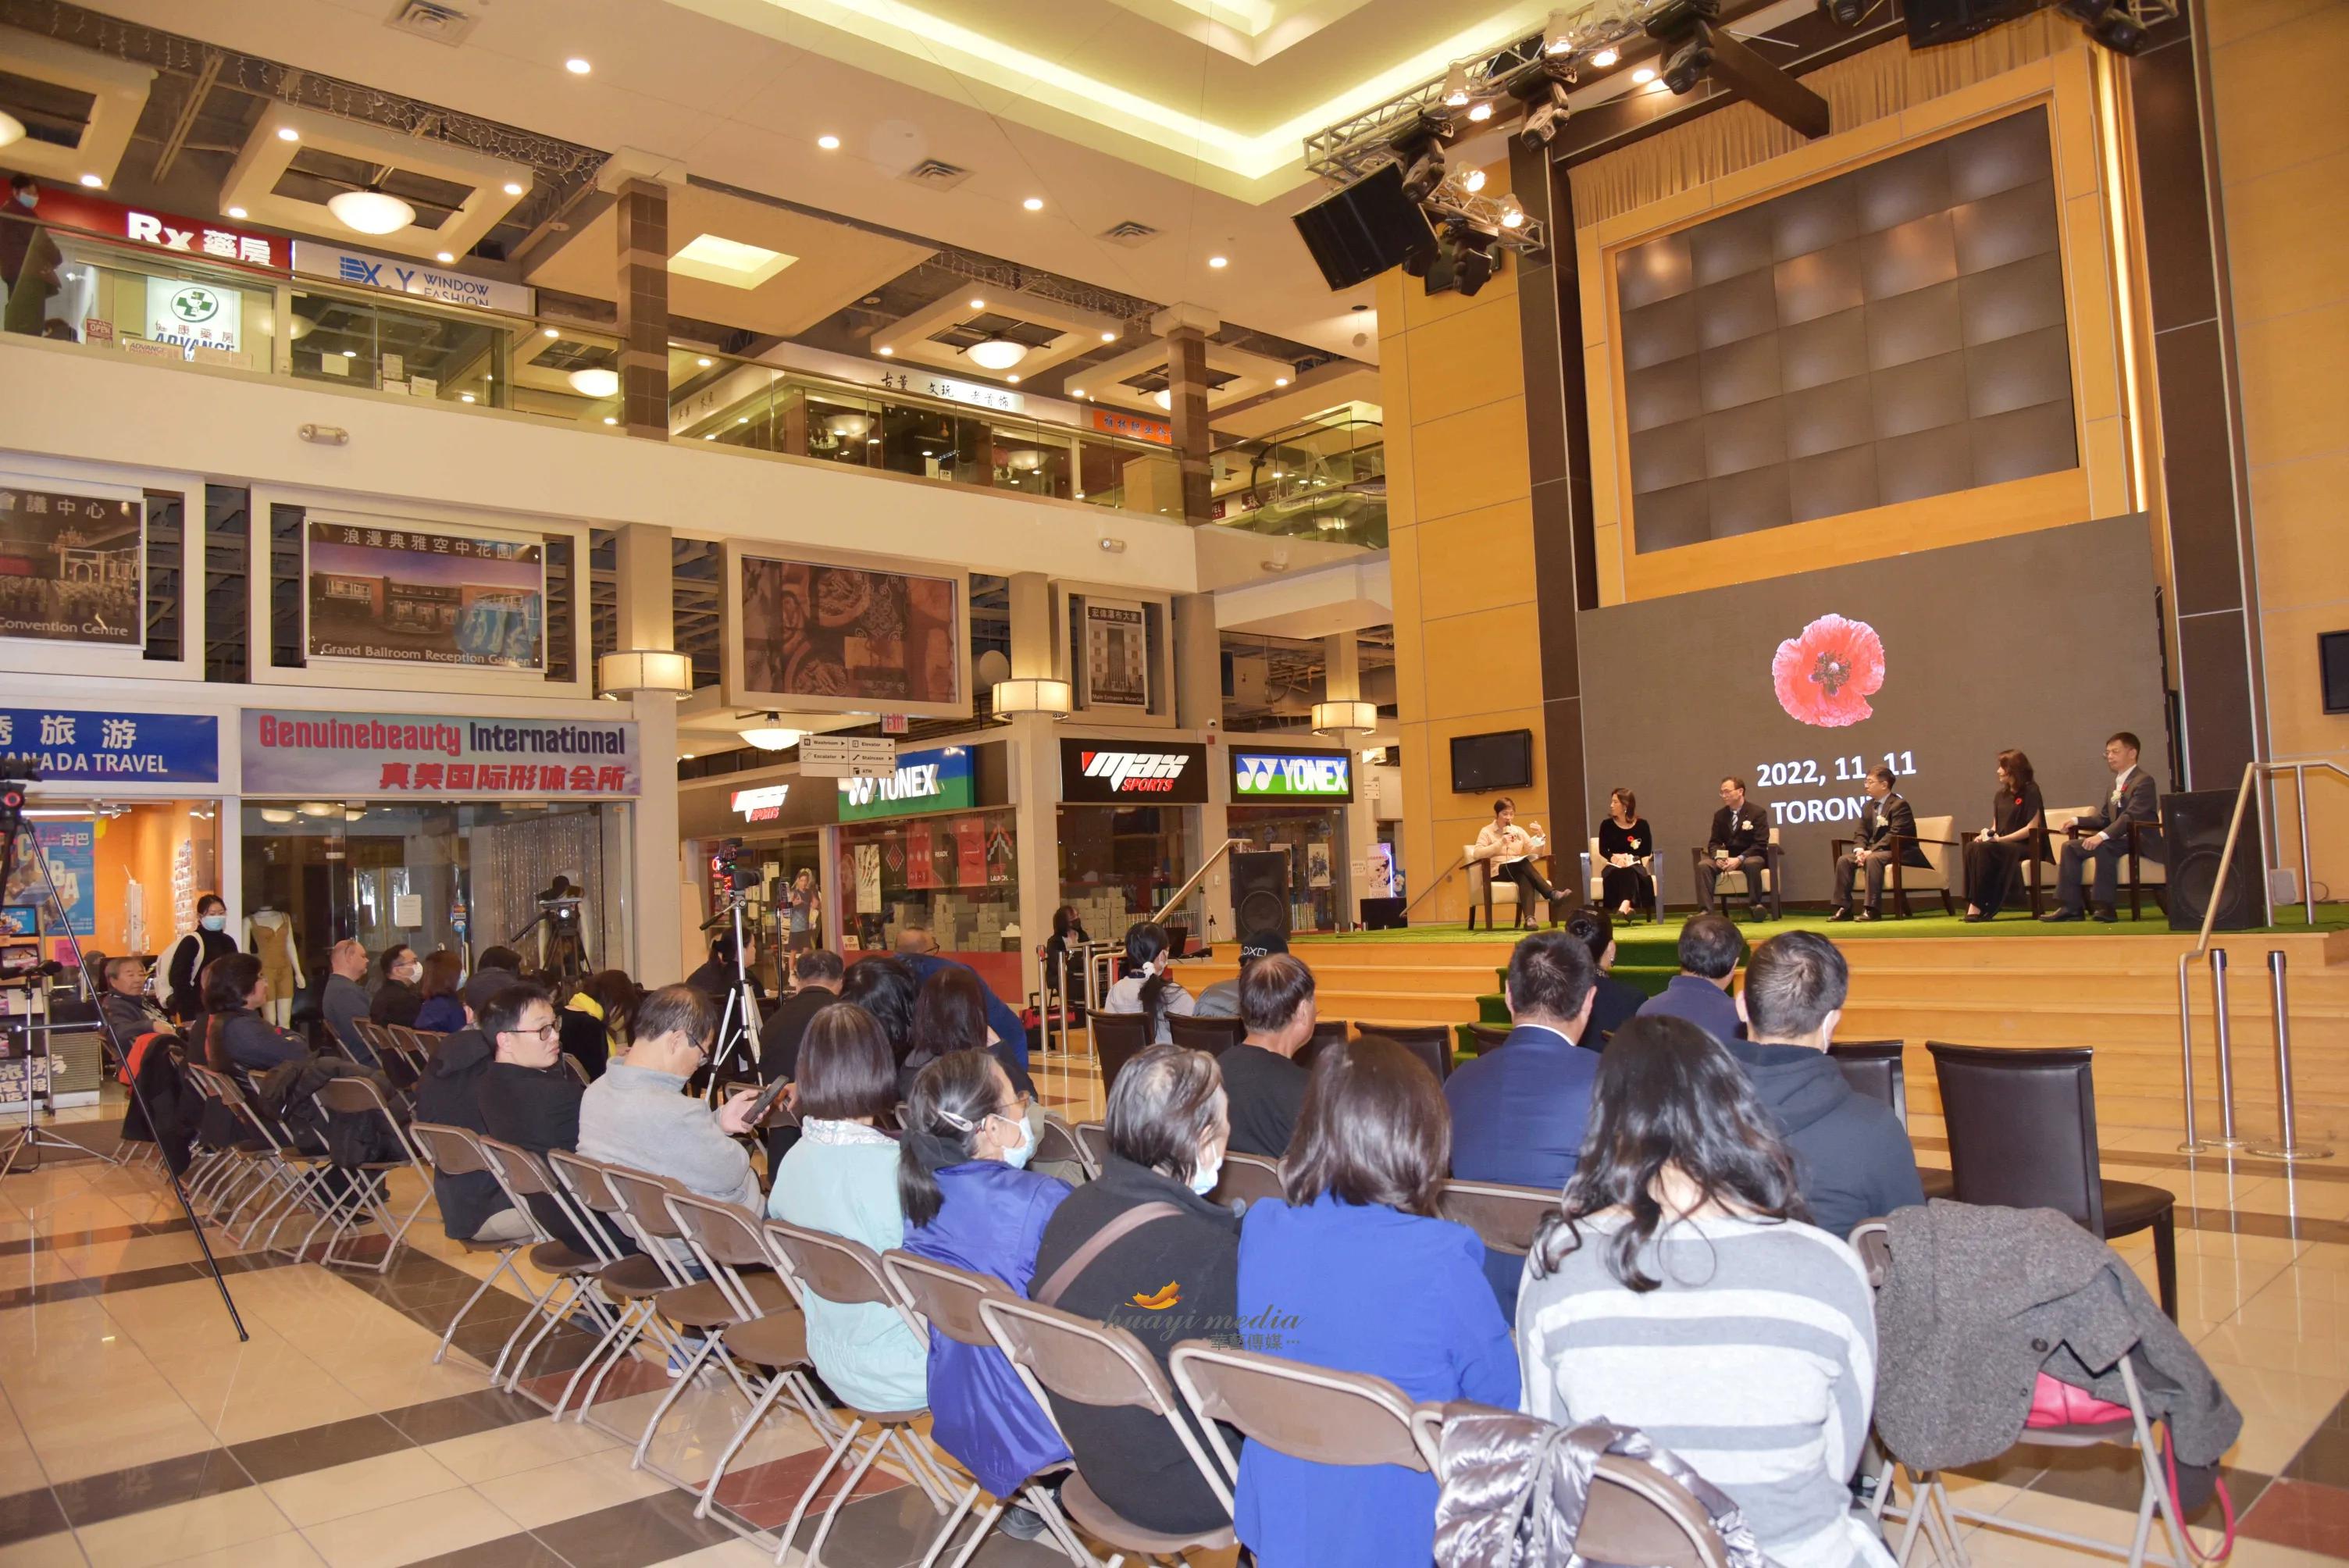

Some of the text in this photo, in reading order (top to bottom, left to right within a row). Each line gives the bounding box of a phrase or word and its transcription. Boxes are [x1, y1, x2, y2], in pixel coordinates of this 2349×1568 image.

[128, 212, 194, 251] Rx
[424, 273, 489, 296] WINDOW
[424, 287, 489, 306] FASHION
[90, 323, 111, 333] OPEN
[82, 622, 128, 636] Centre
[321, 643, 361, 657] Grand
[365, 647, 421, 660] Ballroom
[425, 649, 484, 665] Reception
[886, 714, 905, 732] EXIT
[260, 715, 626, 757] Genuinebeauty International
[92, 754, 168, 773] TRAVEL
[1280, 758, 1349, 791] YONEX
[1757, 760, 1826, 786] 2022,
[1884, 751, 1916, 775] 11
[379, 762, 626, 791] 真美国际形体会所
[878, 764, 939, 800] YONEX
[1121, 778, 1174, 792] SPORTS
[1770, 793, 1903, 825] TORON
[61, 832, 90, 846] 古巴
